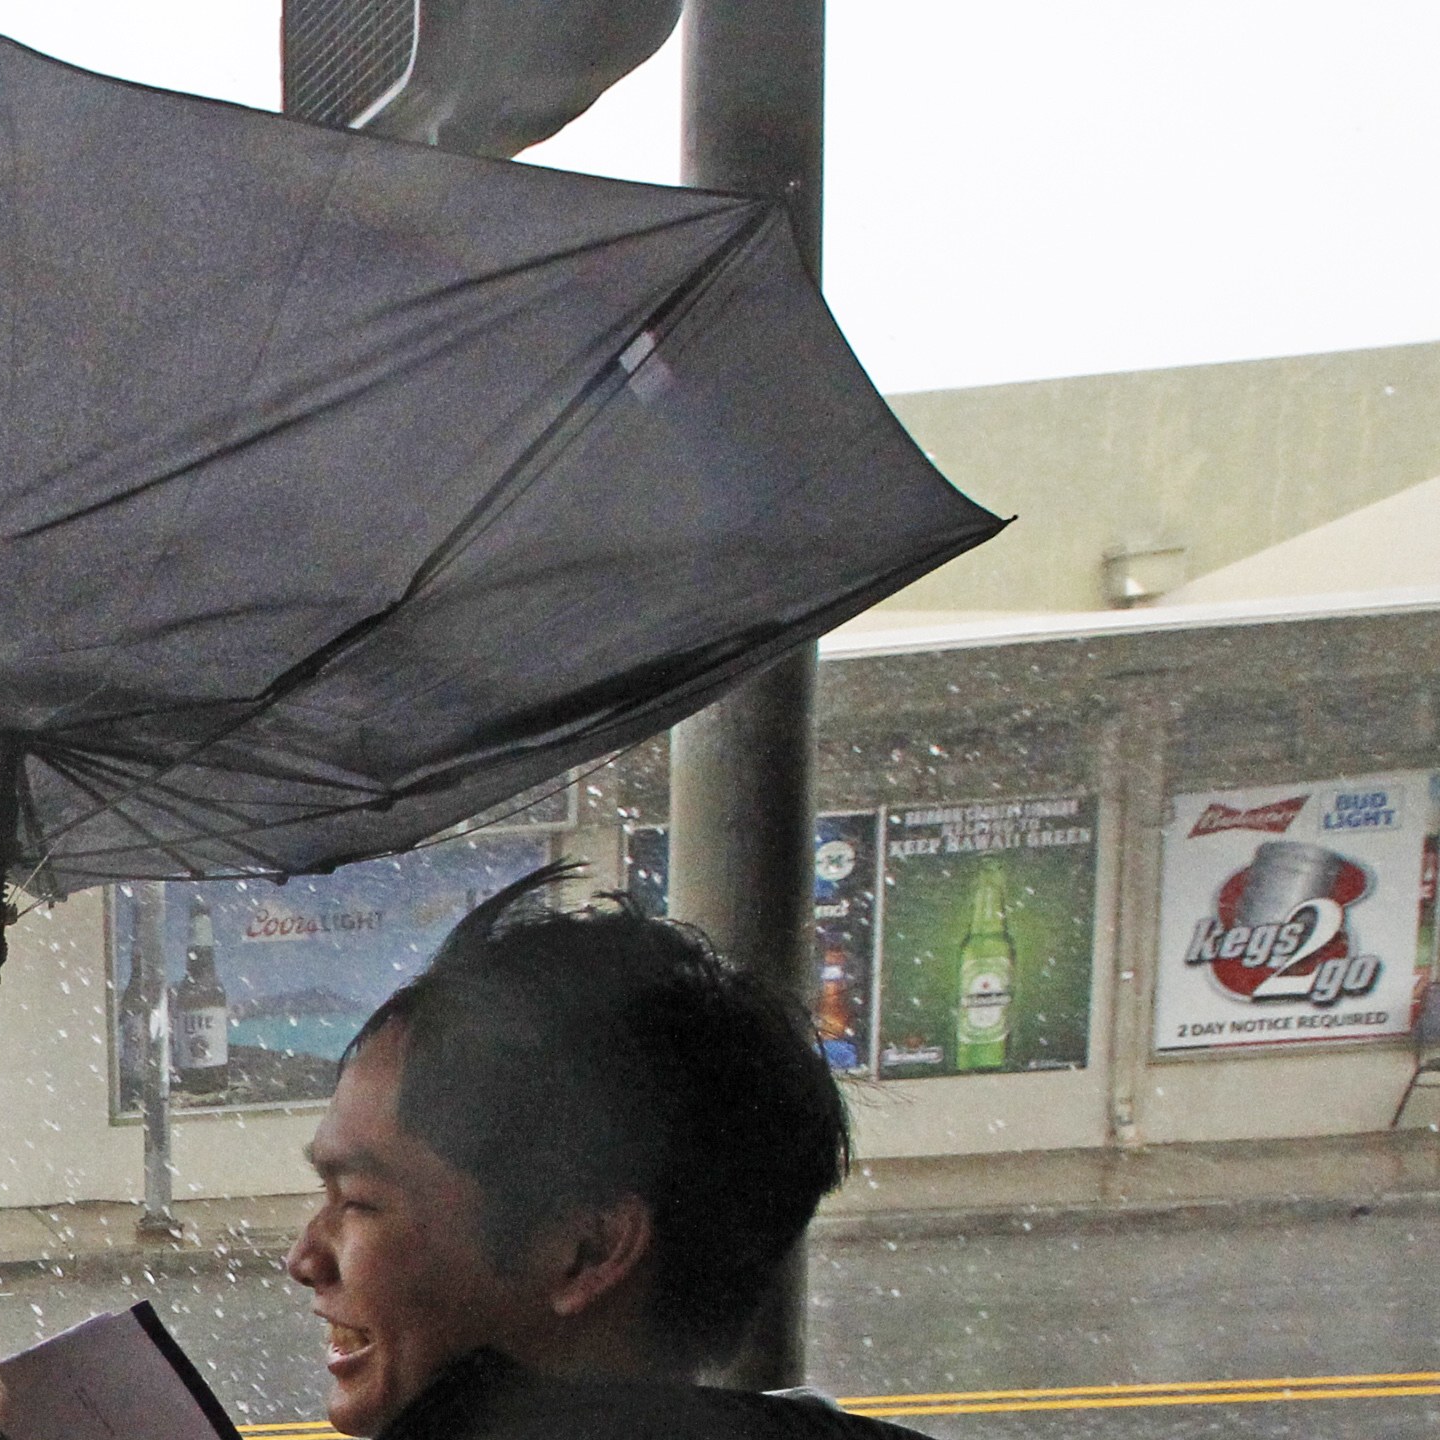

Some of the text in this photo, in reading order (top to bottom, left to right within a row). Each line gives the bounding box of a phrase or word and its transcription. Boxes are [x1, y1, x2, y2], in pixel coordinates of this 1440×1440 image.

[1336, 792, 1388, 810] BUD
[1324, 810, 1395, 830] LIGHT
[889, 828, 1090, 858] KEEP HAWAII GREEN
[245, 908, 386, 938] Coors LIGHT
[1253, 897, 1345, 999] 2
[1311, 955, 1380, 1005] go
[1177, 1010, 1389, 1038] 2 DAY NOTICE REQUIRED
